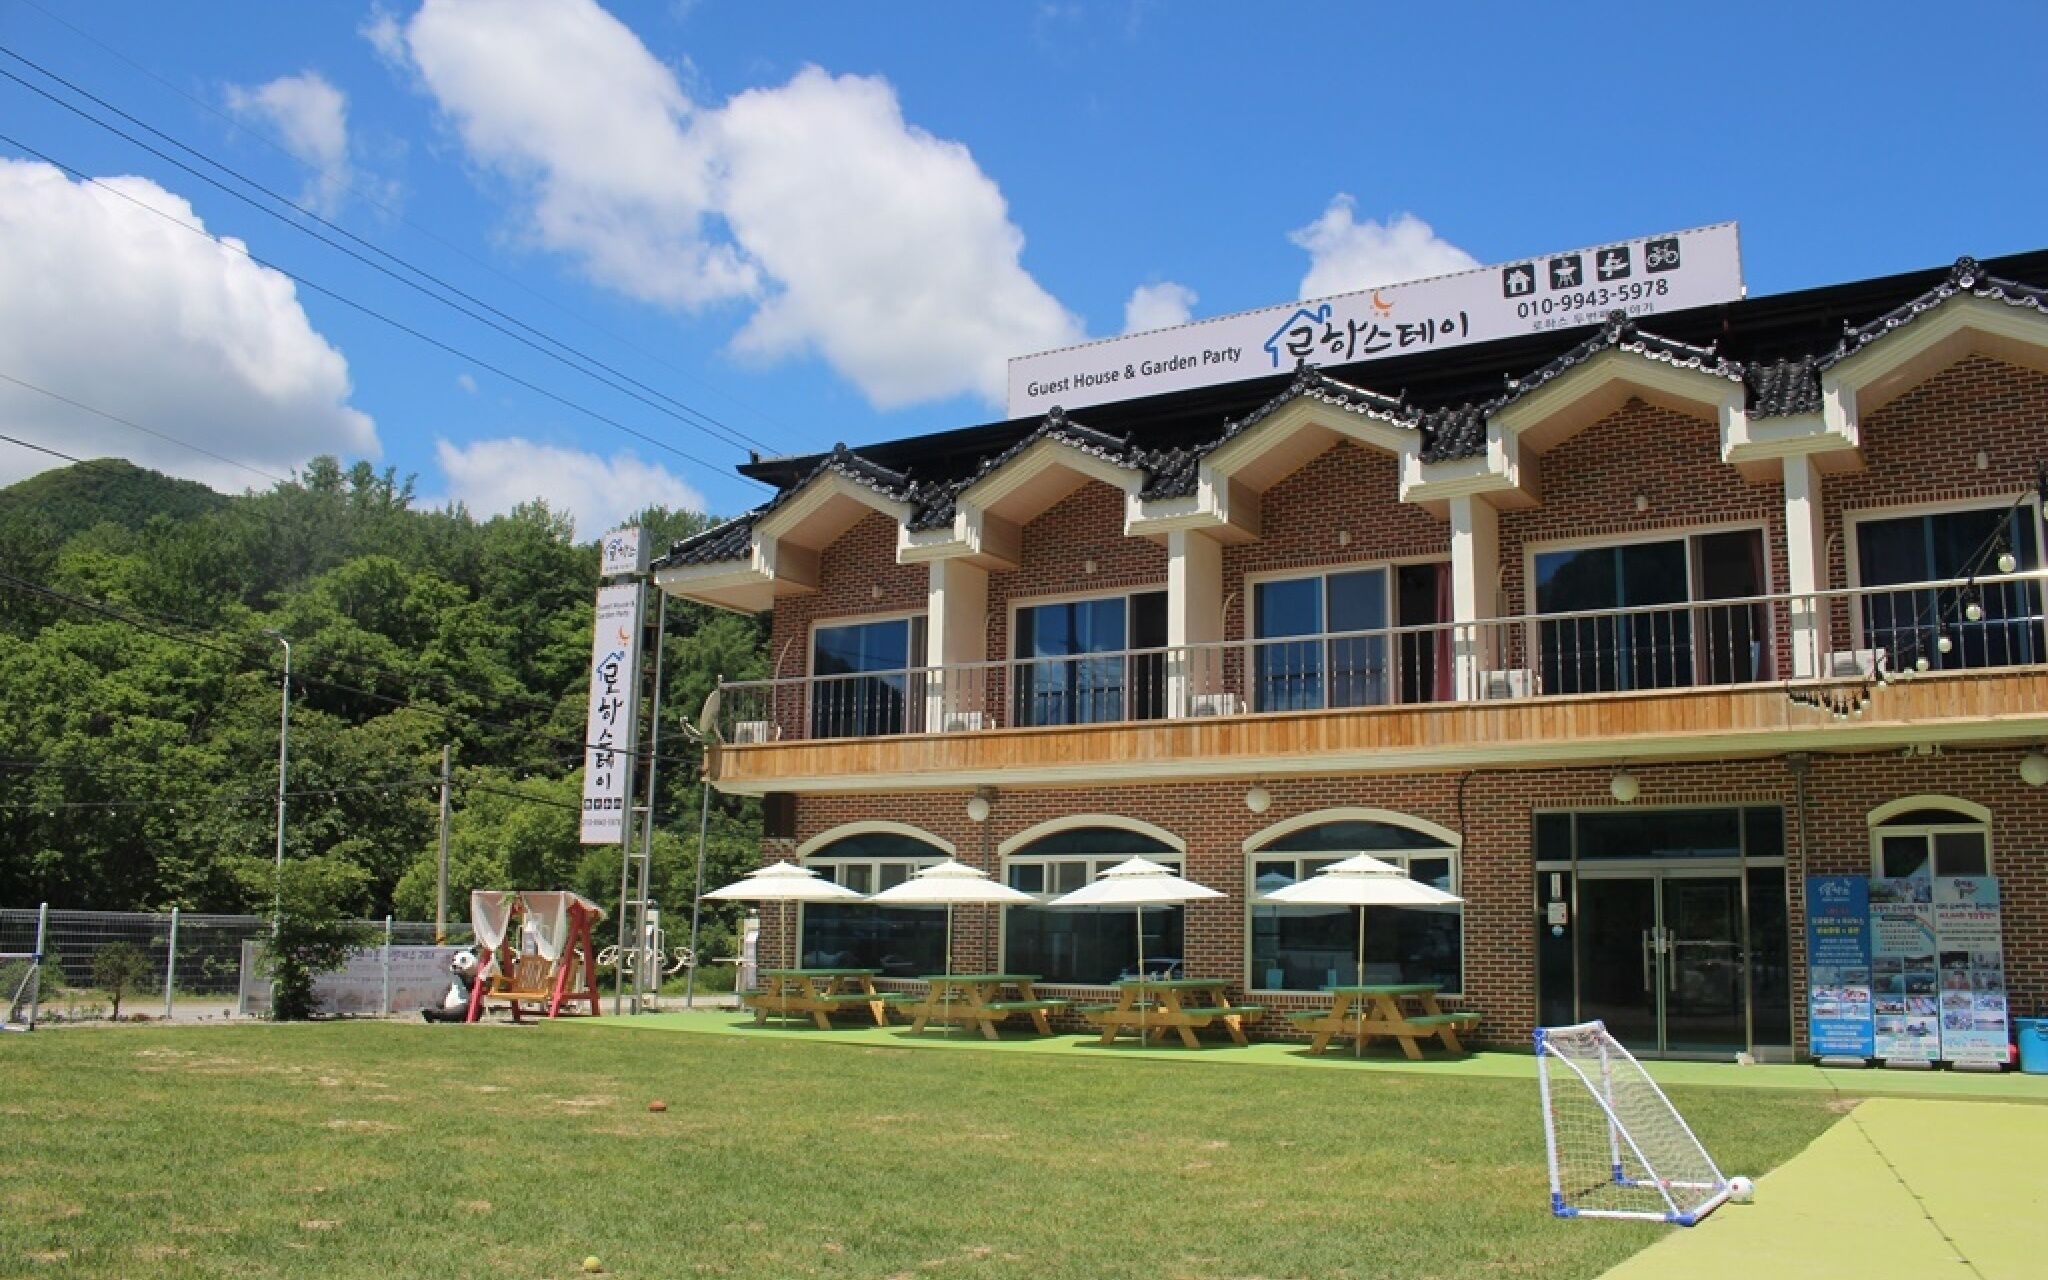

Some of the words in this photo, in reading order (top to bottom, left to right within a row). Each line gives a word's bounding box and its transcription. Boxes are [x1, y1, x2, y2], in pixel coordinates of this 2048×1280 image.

[1518, 278, 1669, 318] 010-9943-5978
[1027, 378, 1069, 398] Guest
[1073, 369, 1120, 389] House
[1123, 364, 1136, 379] &
[1140, 353, 1197, 377] Garden
[1202, 346, 1242, 366] Party
